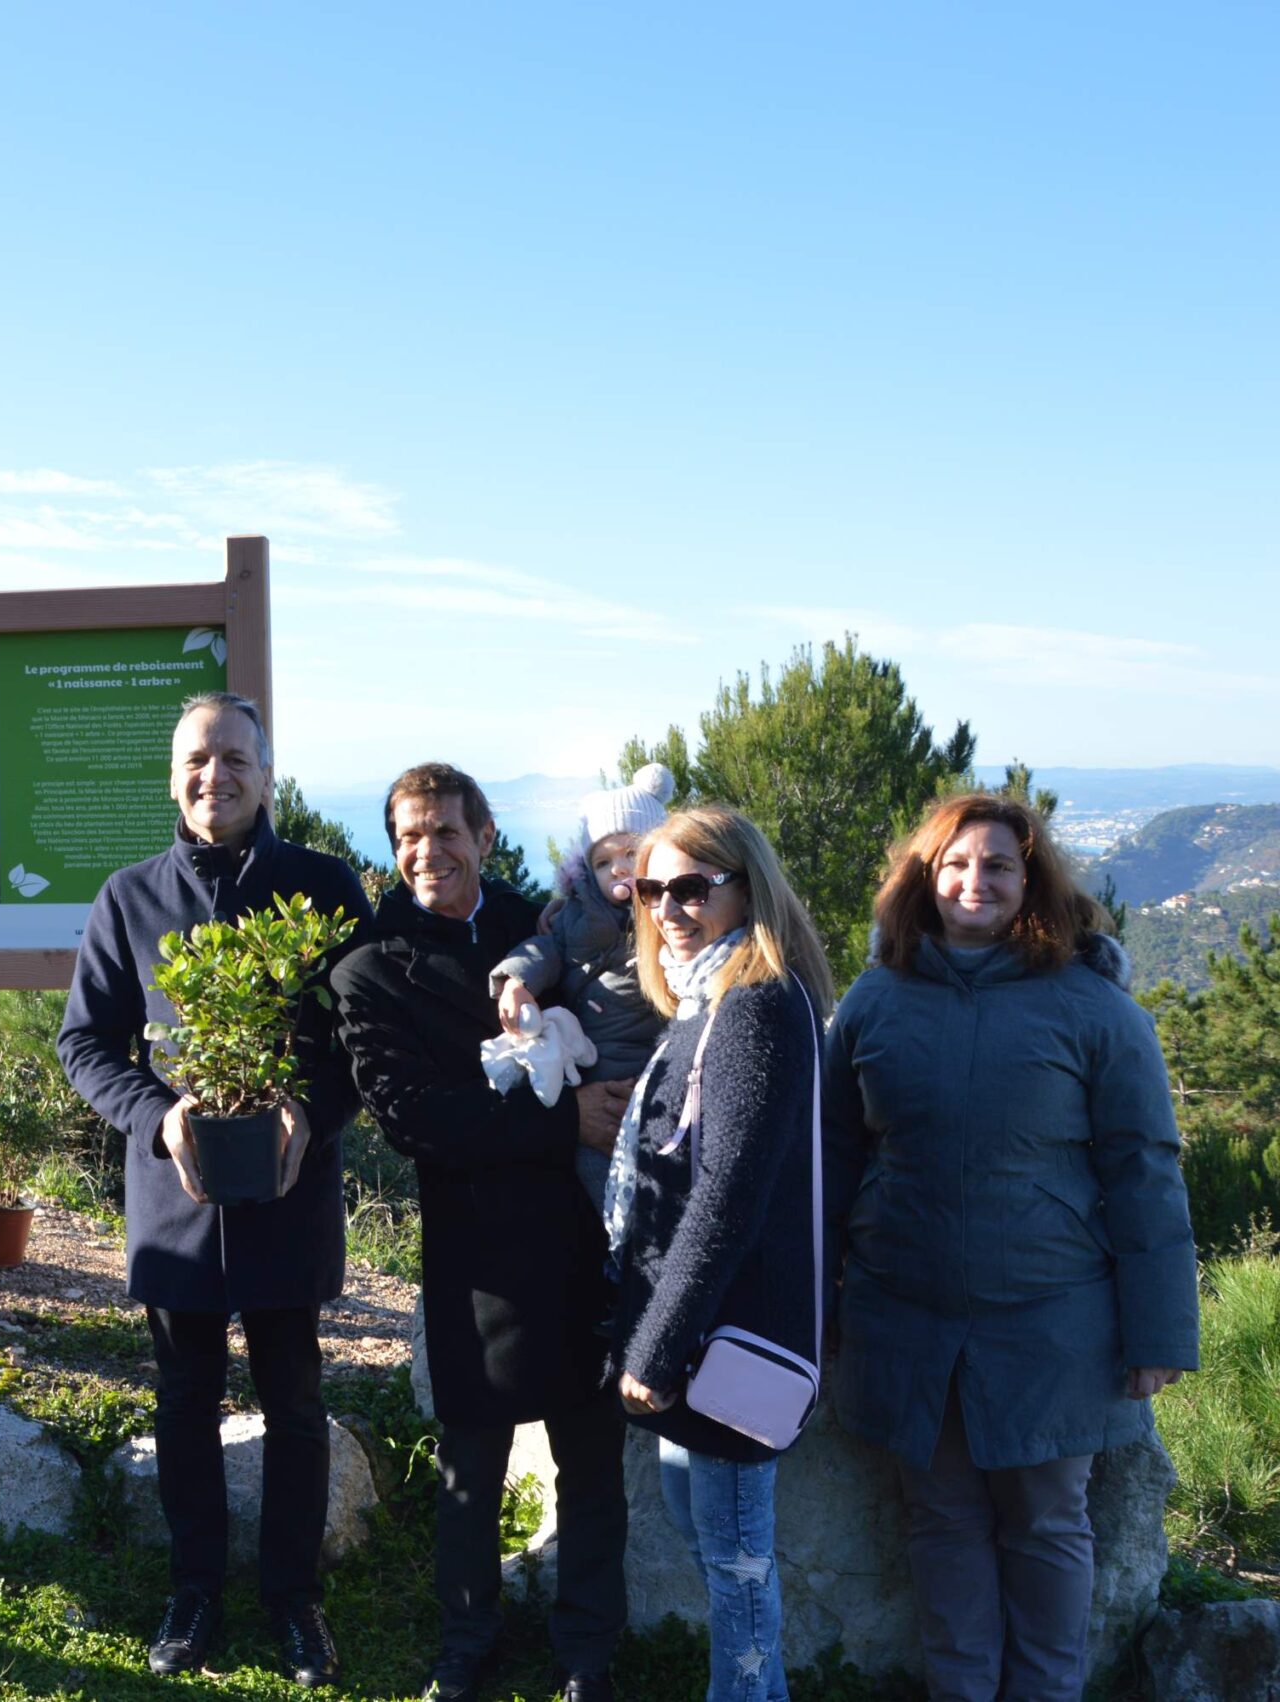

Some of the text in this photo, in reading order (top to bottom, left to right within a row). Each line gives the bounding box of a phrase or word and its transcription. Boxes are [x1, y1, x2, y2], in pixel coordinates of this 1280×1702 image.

[25, 660, 203, 675] Le programme de reboisement
[64, 678, 122, 688] naissance
[139, 677, 172, 686] arbre
